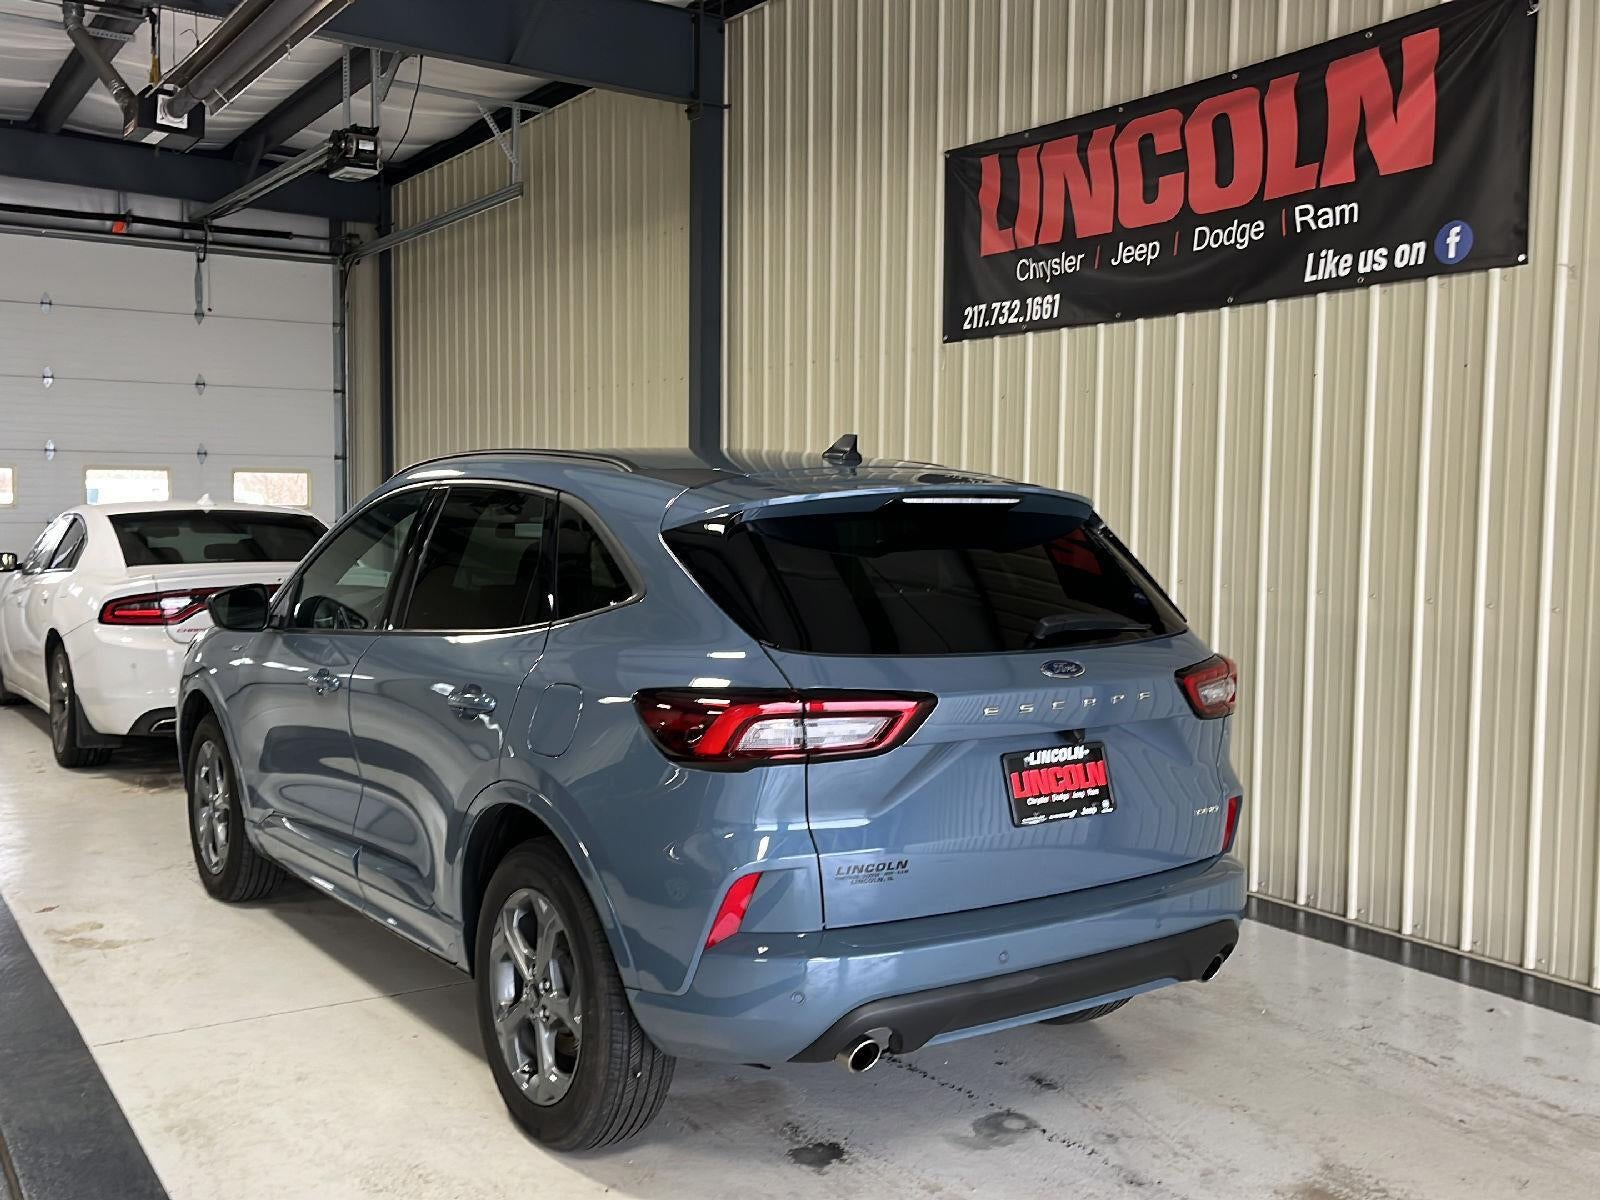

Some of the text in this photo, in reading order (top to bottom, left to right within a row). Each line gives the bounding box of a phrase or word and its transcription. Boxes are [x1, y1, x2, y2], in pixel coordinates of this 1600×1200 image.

[979, 28, 1440, 257] LINCOLN
[1016, 201, 1360, 282] Chrysler Jeep Dodge Ram
[1303, 249, 1353, 283] Like
[1357, 247, 1388, 274] us
[1394, 240, 1427, 268] on
[962, 293, 1061, 330] 217.732.1661
[1026, 745, 1086, 766] LINCOLN
[1010, 760, 1108, 799] LINCOLN
[835, 859, 909, 876] LINCOLN
